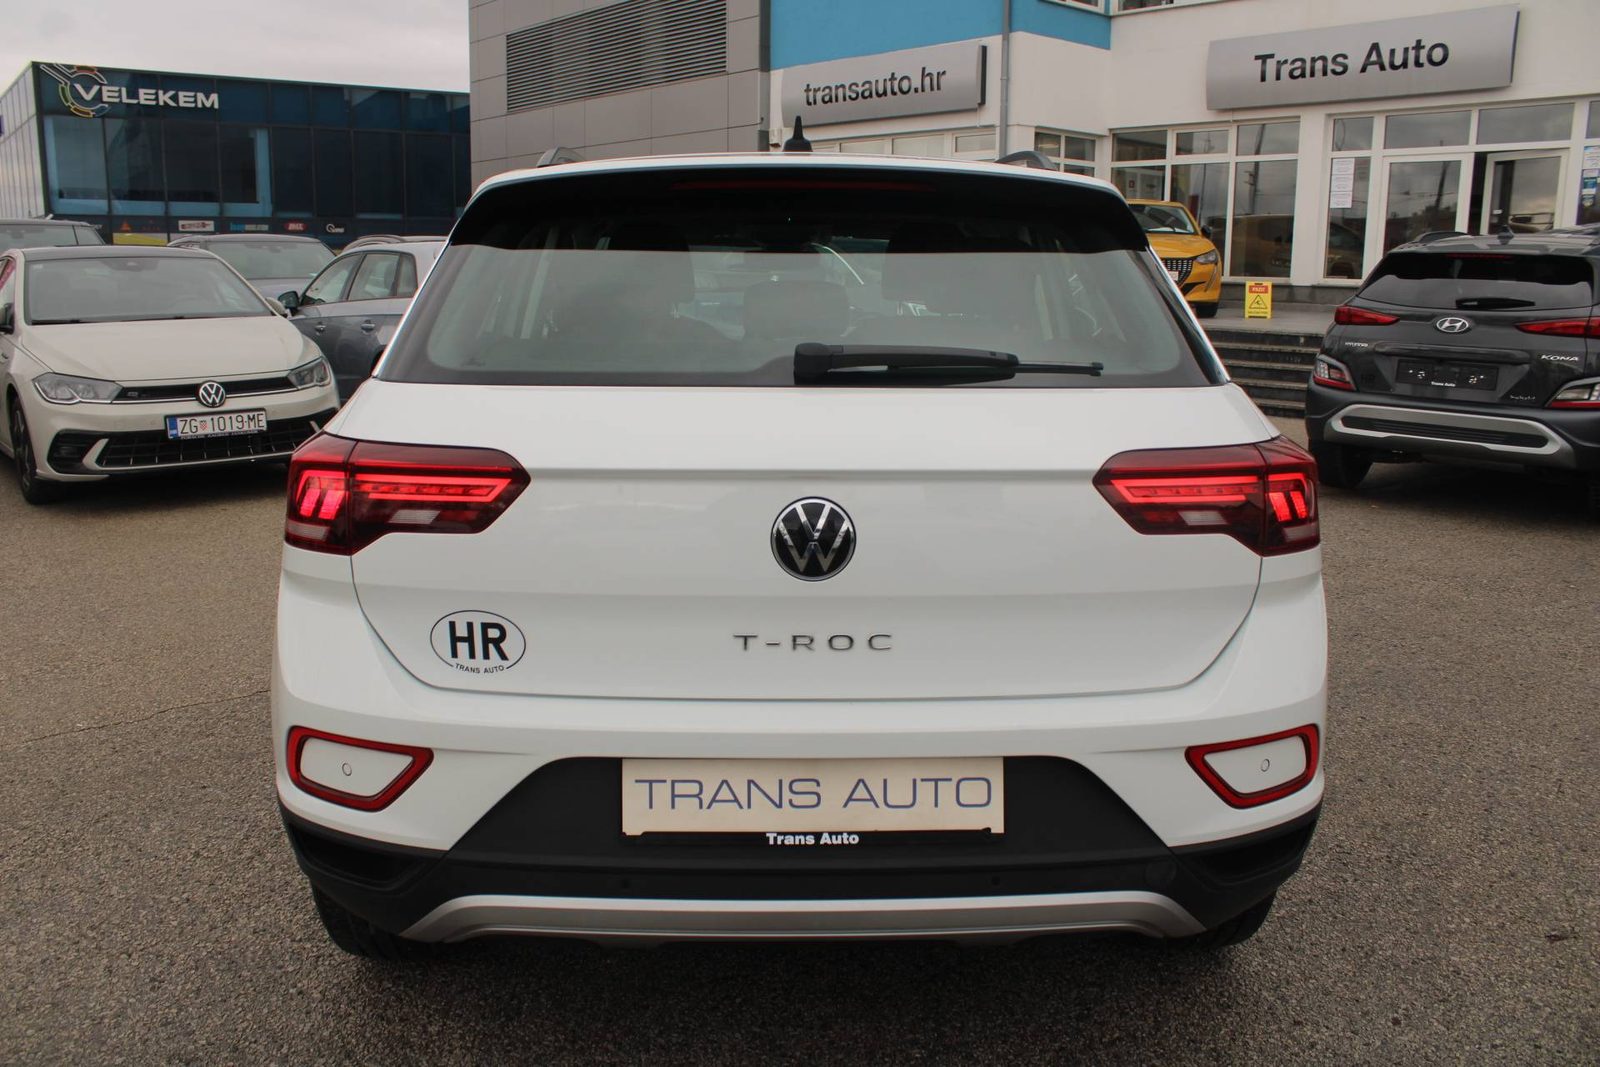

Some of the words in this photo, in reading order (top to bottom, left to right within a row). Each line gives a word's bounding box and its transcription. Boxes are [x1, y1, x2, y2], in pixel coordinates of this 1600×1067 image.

[1254, 52, 1349, 83] Trans
[1359, 38, 1450, 74] Auto
[73, 83, 219, 109] VELEKEM
[804, 66, 945, 105] transauto.hr
[1540, 354, 1579, 363] KONA
[179, 418, 199, 435] ZG
[448, 620, 510, 661] HR
[733, 633, 893, 651] T-ROC
[454, 662, 481, 674] TRANS
[482, 663, 506, 674] AUTO
[634, 778, 822, 810] TRANS
[842, 776, 992, 809] AUTO
[766, 832, 815, 845] Trans
[819, 832, 859, 845] Auto
